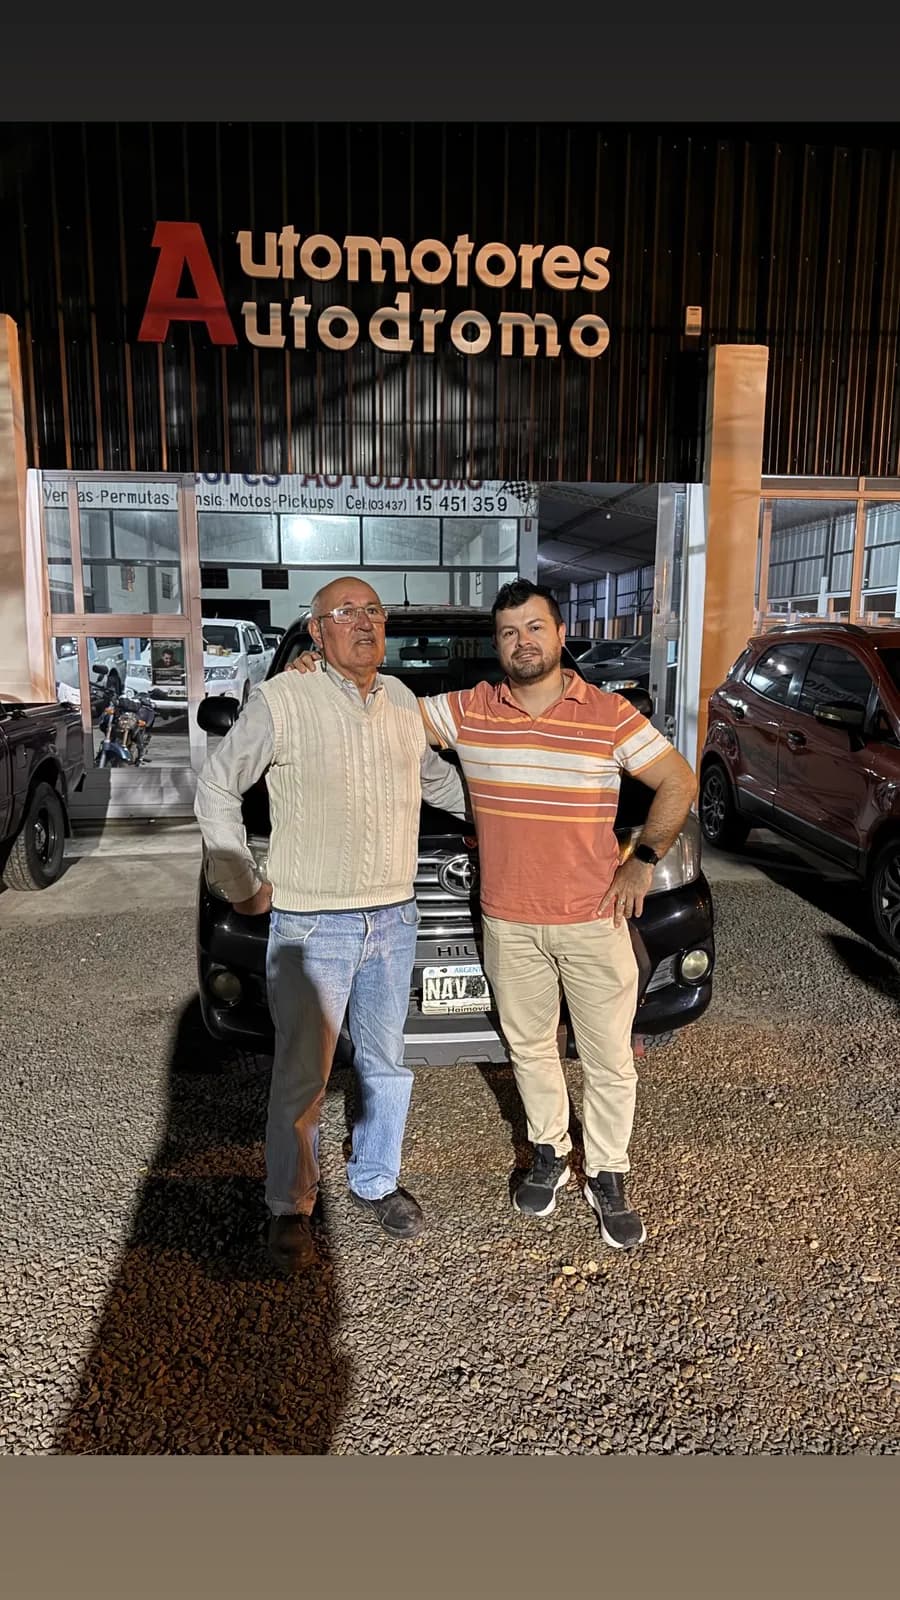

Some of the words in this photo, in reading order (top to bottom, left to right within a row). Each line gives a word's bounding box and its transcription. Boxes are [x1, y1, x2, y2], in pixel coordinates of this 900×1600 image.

[278, 493, 334, 512] Pickups
[416, 495, 432, 511] 15
[440, 495, 466, 512] 451
[472, 496, 507, 513] 359
[437, 945, 476, 957] HIL
[426, 977, 468, 1001] NAV
